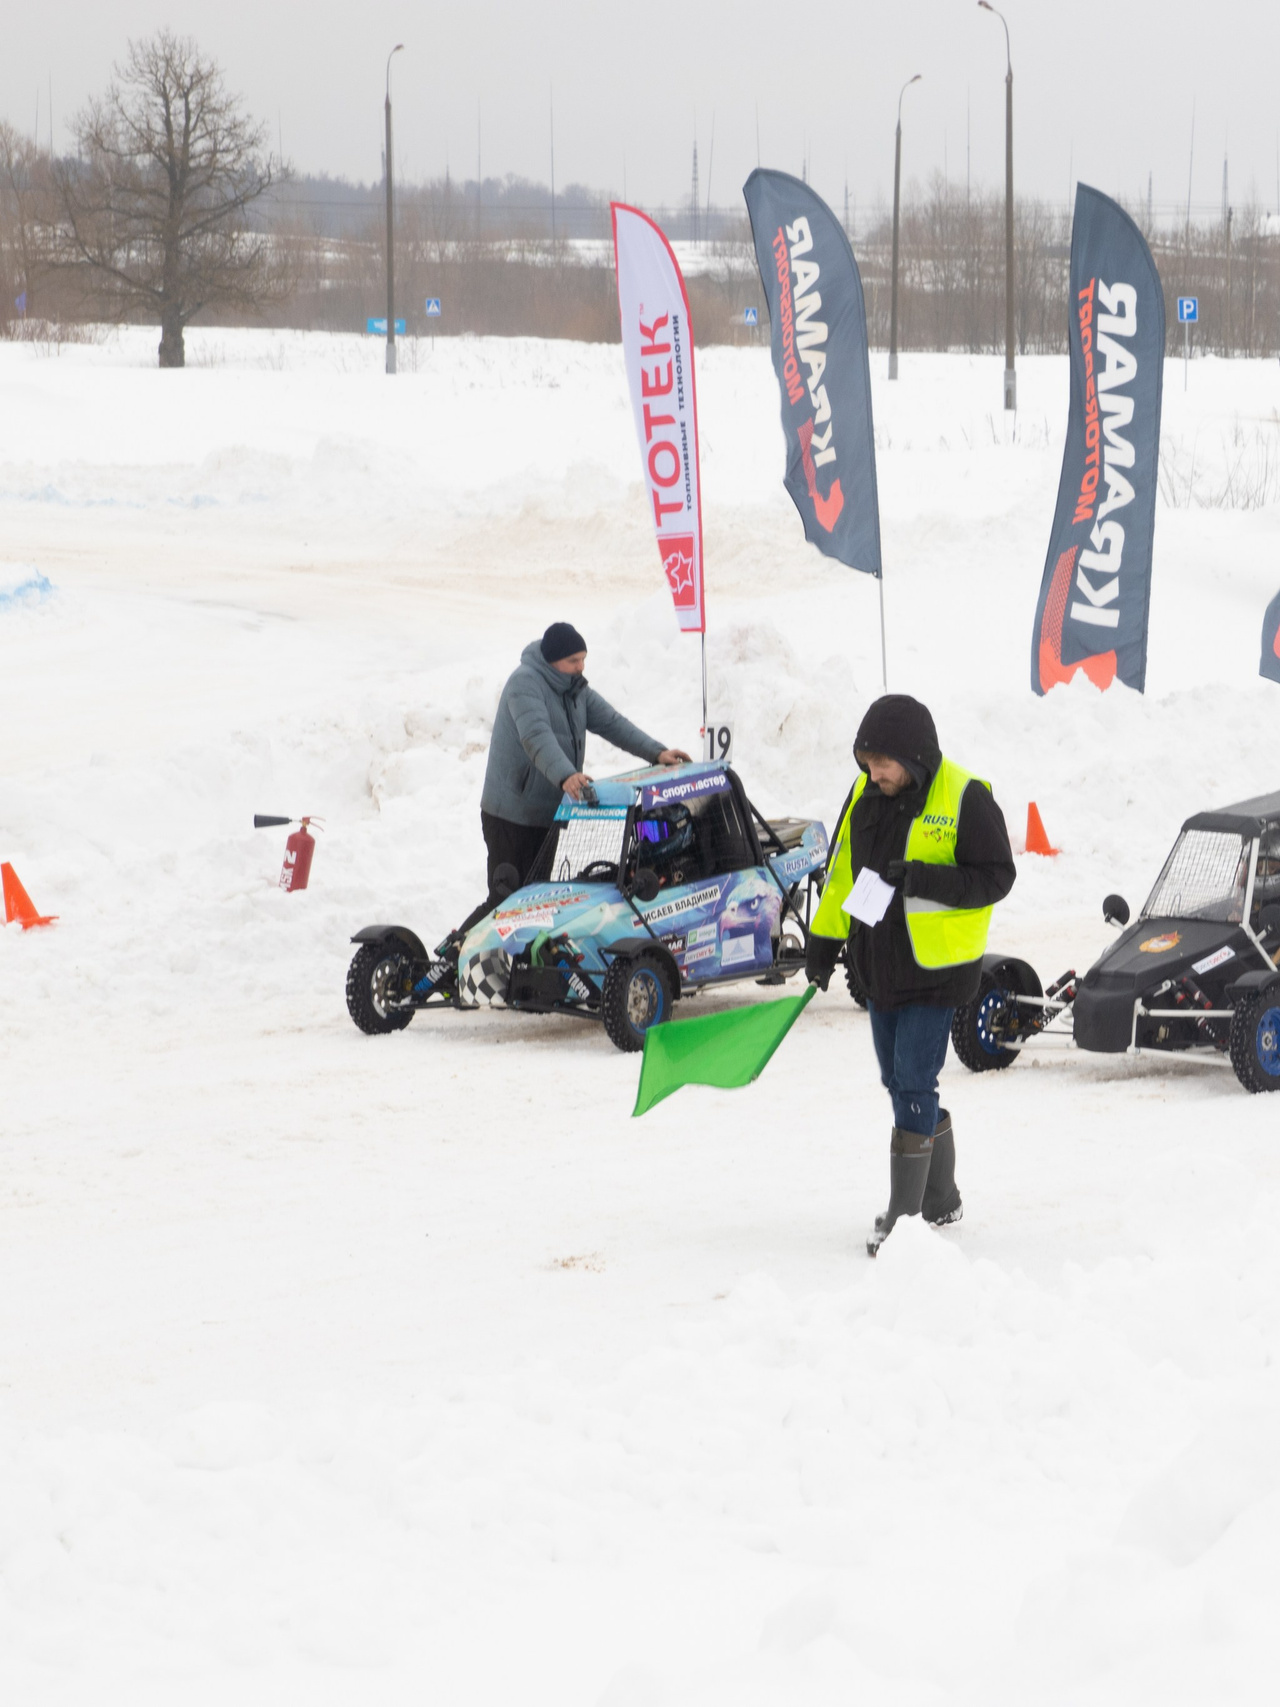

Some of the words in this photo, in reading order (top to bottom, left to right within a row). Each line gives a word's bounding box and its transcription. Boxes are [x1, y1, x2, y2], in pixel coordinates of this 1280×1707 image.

[707, 726, 731, 760] 19
[644, 903, 674, 922] ИСАЕВ
[675, 887, 720, 911] ВЛАДИМИР
